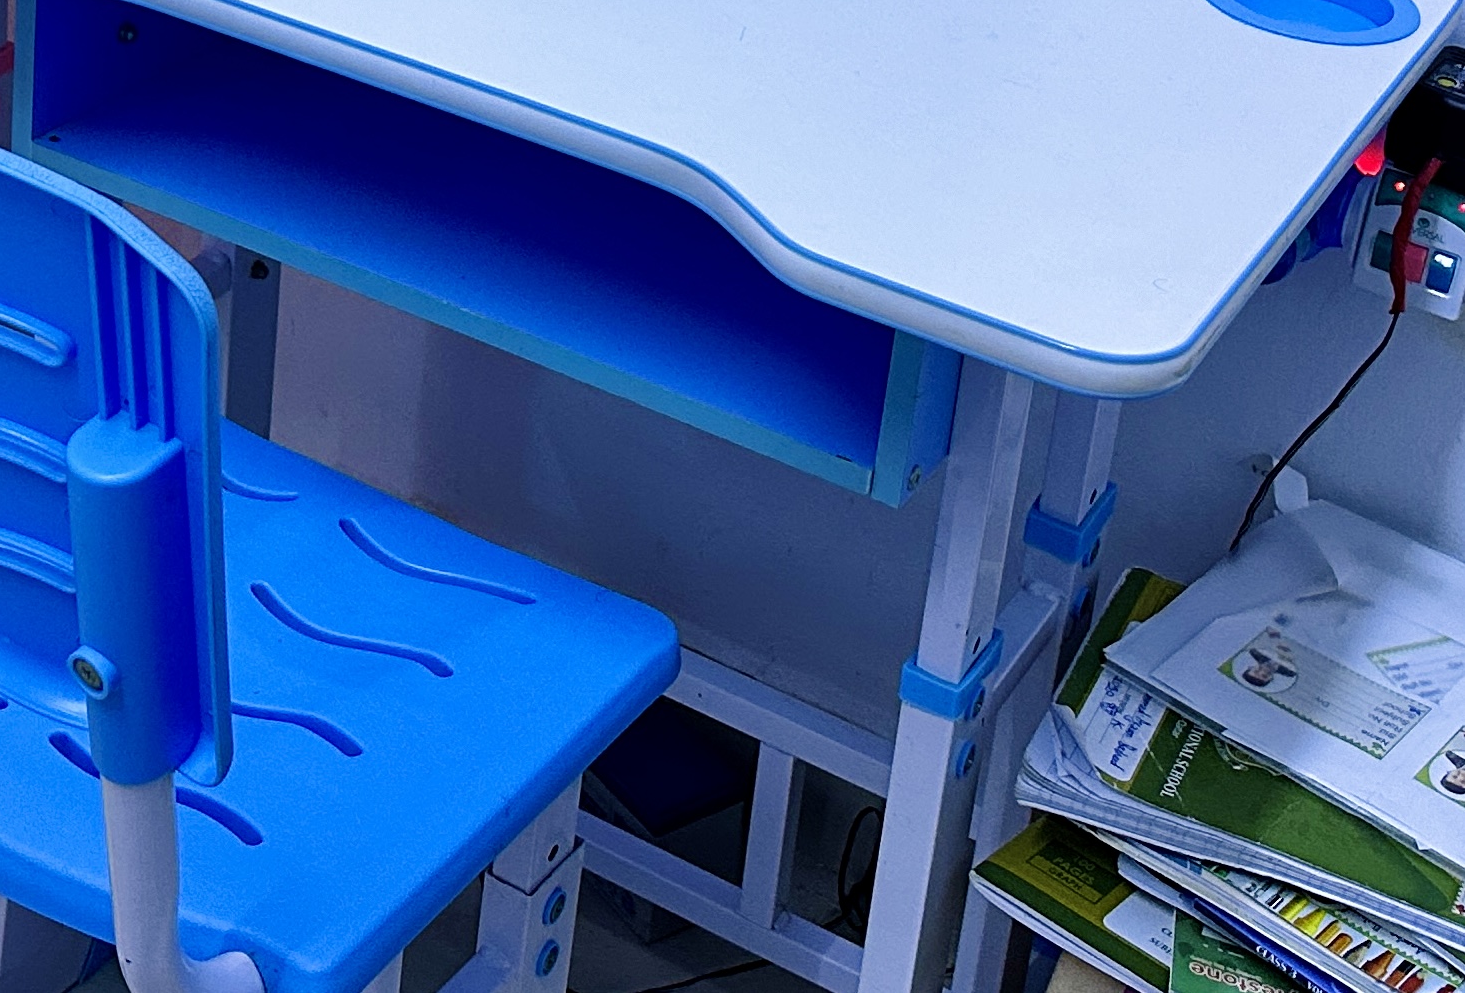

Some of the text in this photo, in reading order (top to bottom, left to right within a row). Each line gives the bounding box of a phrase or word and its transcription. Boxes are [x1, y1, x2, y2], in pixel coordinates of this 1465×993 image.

[1361, 729, 1389, 746] Name
[1160, 759, 1189, 797] SCHOOL
[1049, 866, 1083, 890] GRAPH
[1053, 857, 1094, 883] PAGES
[1255, 945, 1287, 973] CLASS
